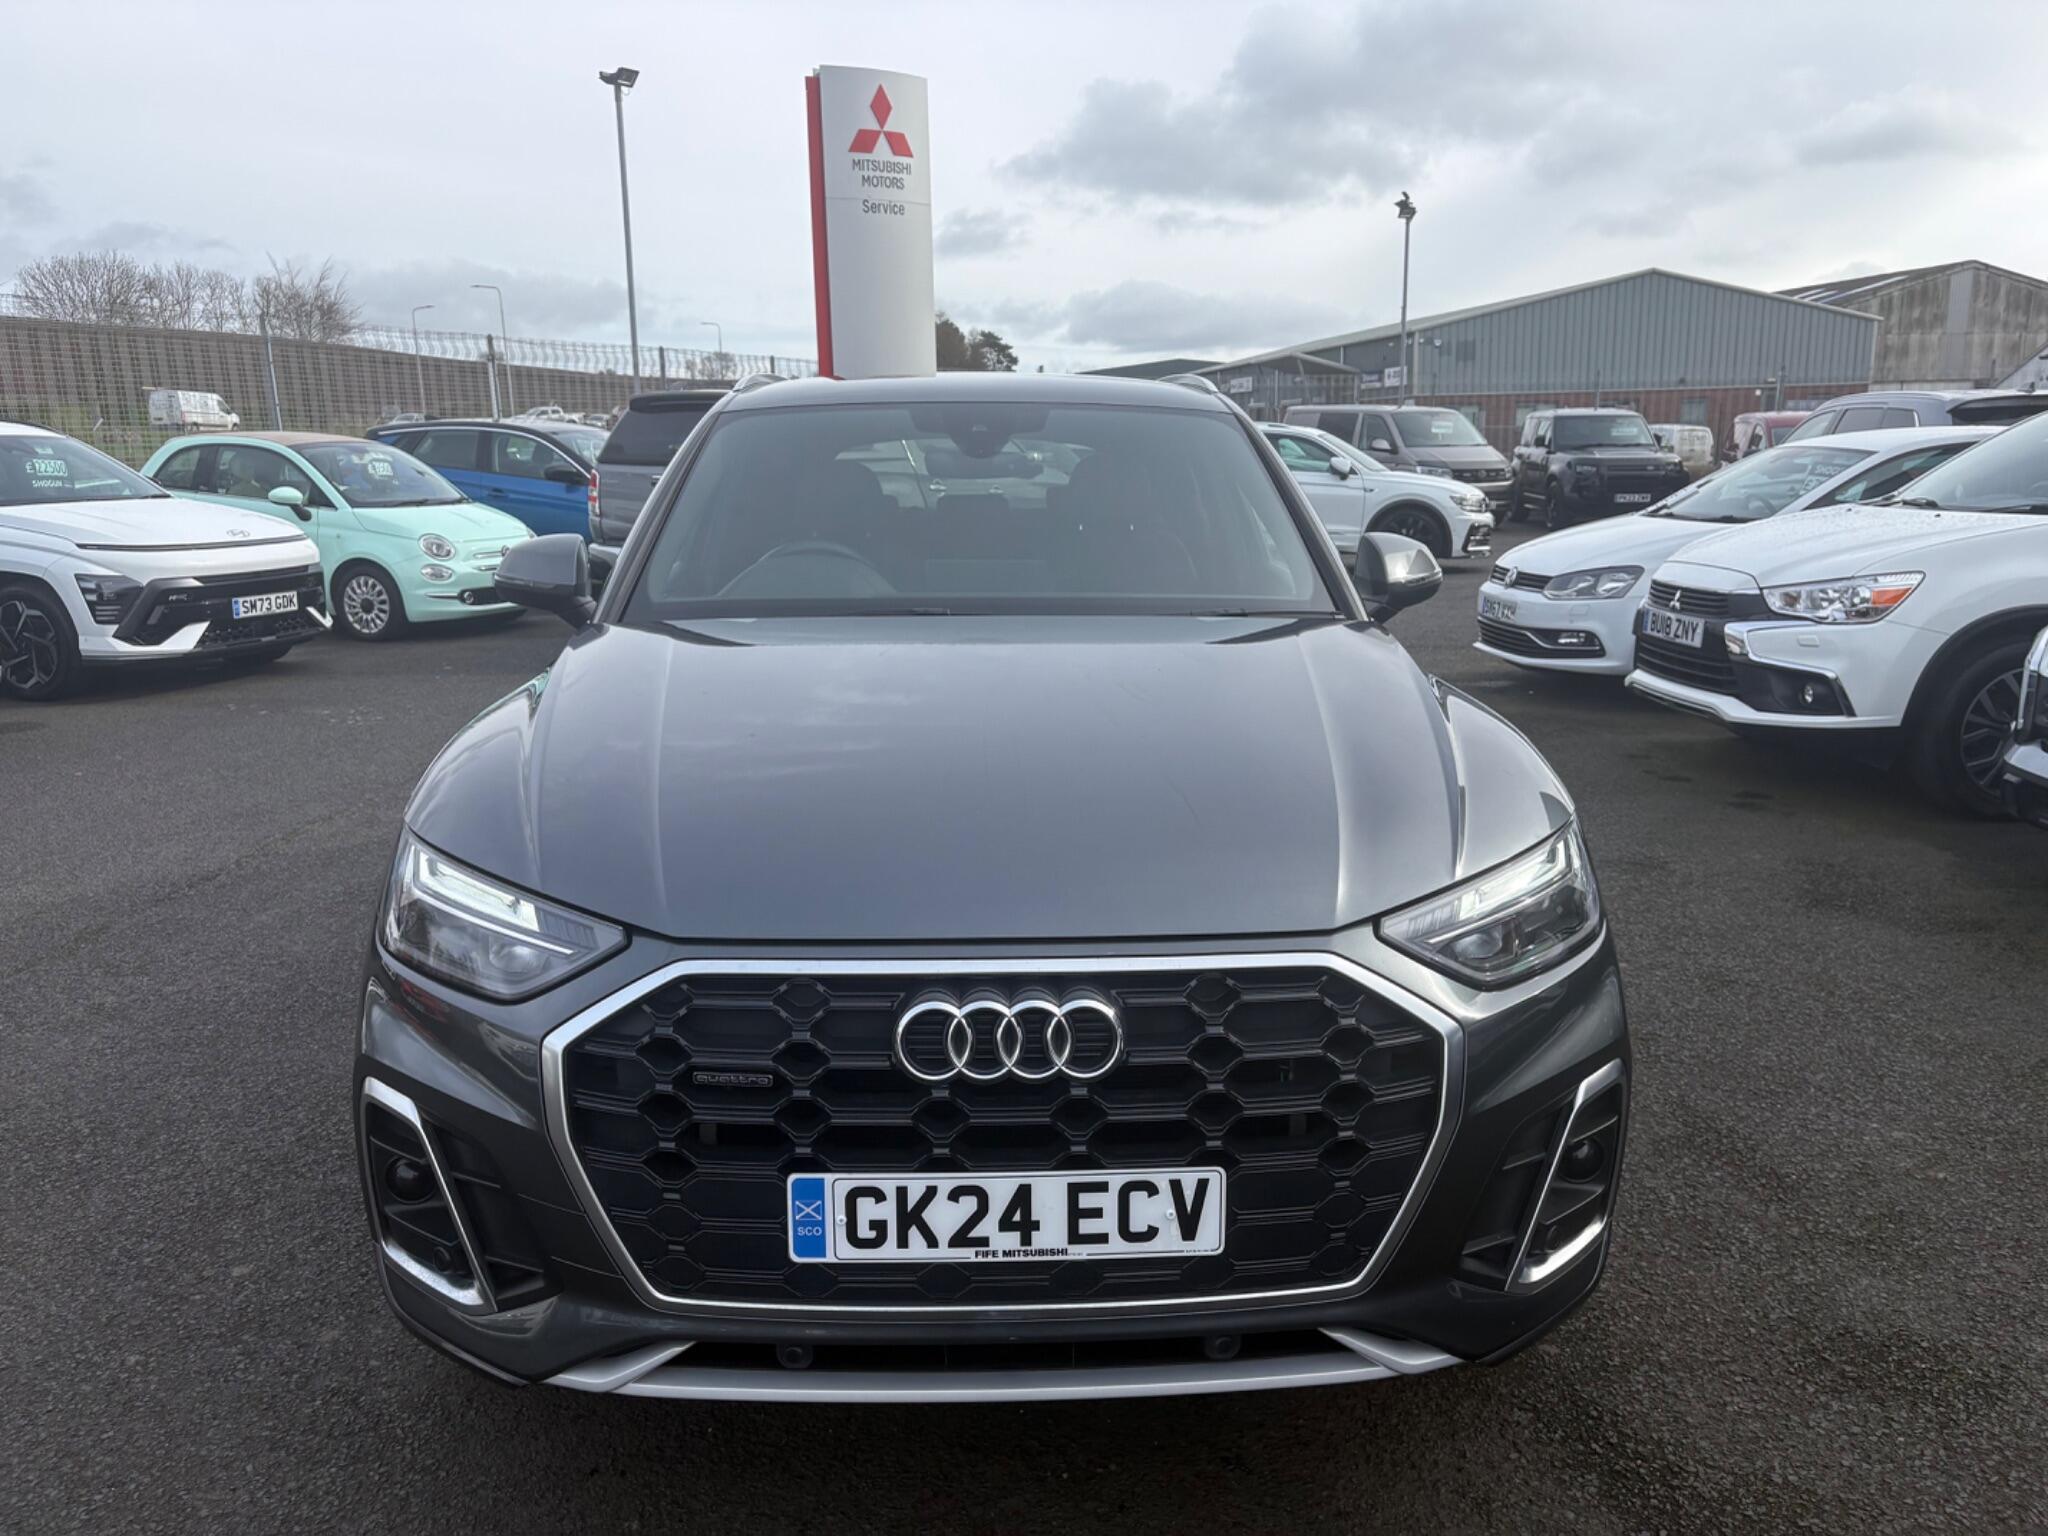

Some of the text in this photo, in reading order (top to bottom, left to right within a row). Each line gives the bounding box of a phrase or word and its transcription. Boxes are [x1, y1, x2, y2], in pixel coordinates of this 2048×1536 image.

[852, 159, 911, 175] MITSUBISHI
[861, 174, 905, 190] MOTORS
[862, 198, 905, 215] Service
[242, 594, 296, 614] SM73 GDK
[1674, 618, 1699, 643] ZNY
[844, 1177, 1211, 1250] GK24 ECV
[797, 1226, 823, 1237] SCO
[974, 1249, 1000, 1259] FIFE
[1001, 1247, 1069, 1258] MITSUBISHI
